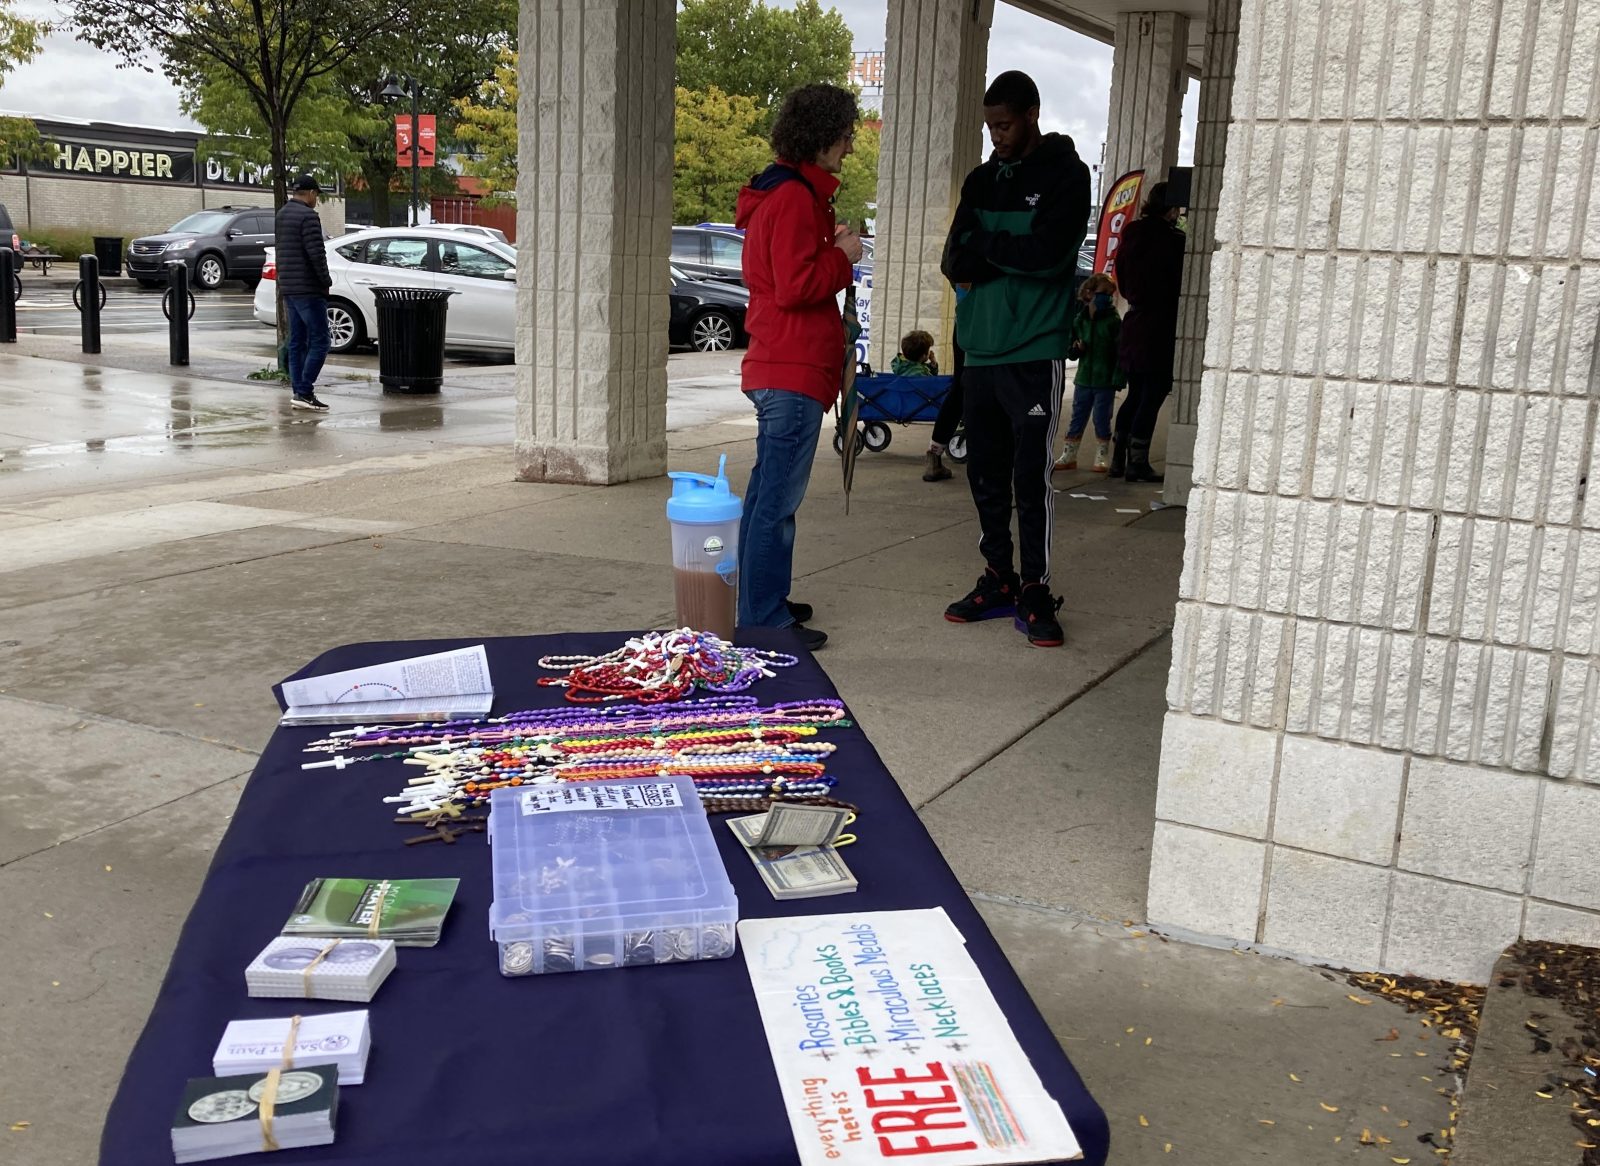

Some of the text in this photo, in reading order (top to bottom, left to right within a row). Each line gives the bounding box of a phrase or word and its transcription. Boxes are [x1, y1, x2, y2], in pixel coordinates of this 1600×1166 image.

[53, 143, 173, 178] HAPPIER
[1102, 212, 1127, 279] OPE
[643, 783, 664, 807] BLESSED
[356, 883, 392, 924] PRAYER
[812, 944, 854, 985] Books
[841, 923, 926, 1042] Miraculous Medals
[793, 984, 836, 1051] Rosaries
[835, 1001, 878, 1046] Bibles
[908, 963, 969, 1038] Necklaces
[269, 1043, 318, 1053] SAIT
[802, 1077, 841, 1160] everything
[831, 1090, 863, 1144] here is
[855, 1061, 978, 1158] FREE
